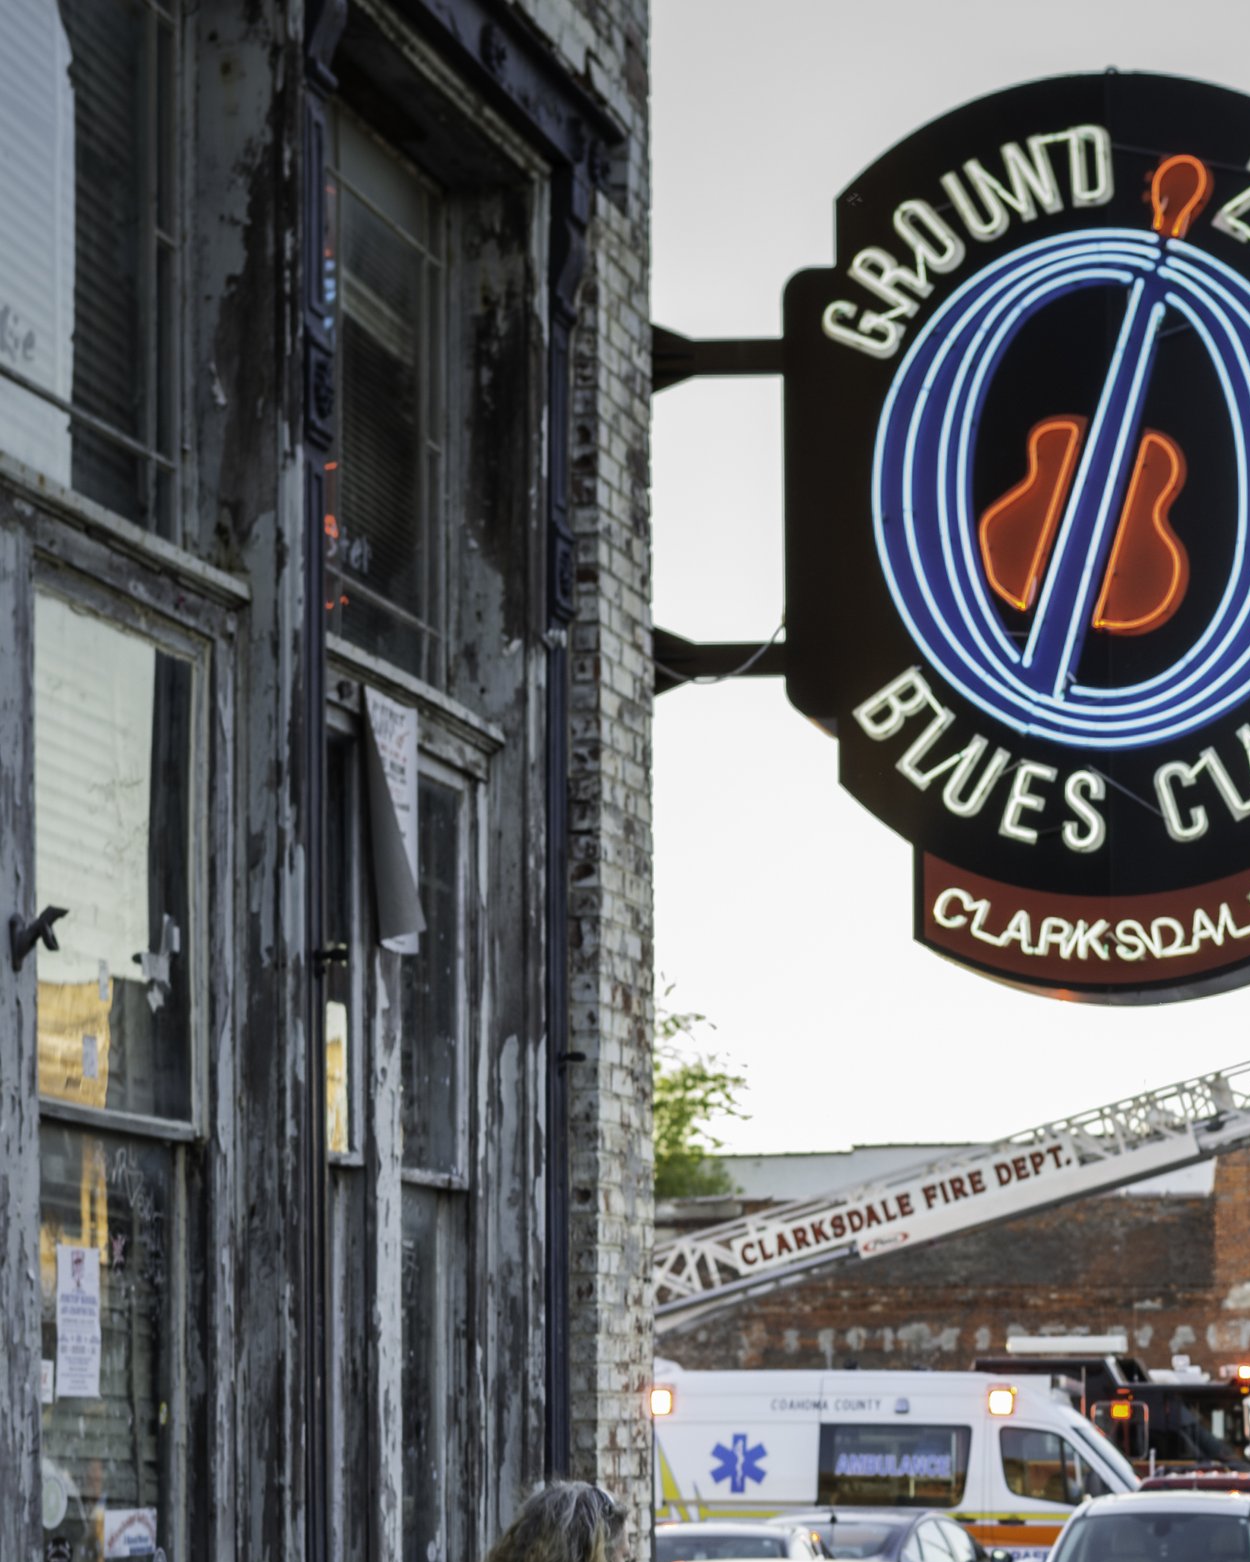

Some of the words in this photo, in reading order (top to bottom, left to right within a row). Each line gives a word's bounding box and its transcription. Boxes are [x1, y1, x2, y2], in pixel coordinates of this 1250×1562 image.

[823, 125, 1113, 359] GROUND
[853, 665, 1108, 854] BLUES
[740, 1190, 915, 1266] CLARKSDALE
[922, 1169, 987, 1210] FIRE
[993, 1144, 1073, 1187] DEPT.
[770, 1398, 829, 1413] COAHOMA
[833, 1397, 882, 1413] COUNTY
[834, 1452, 952, 1477] AMBULANCE
